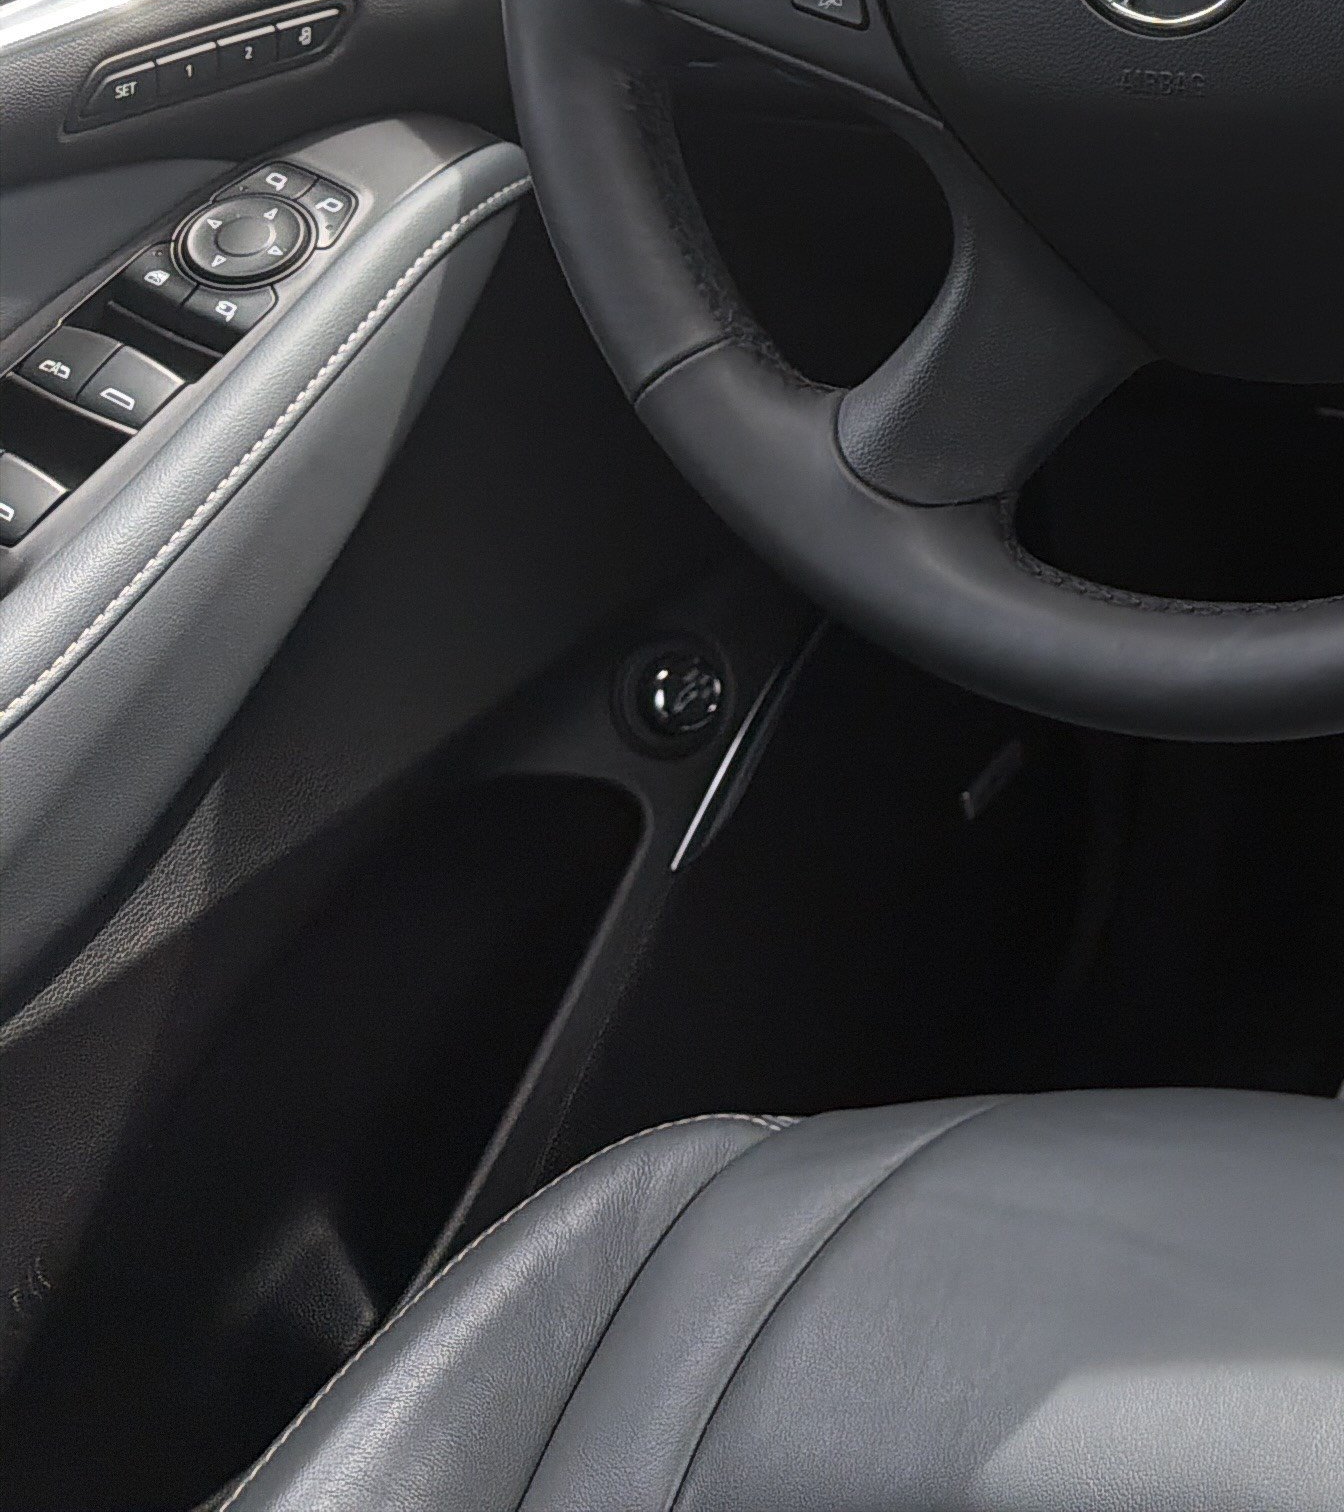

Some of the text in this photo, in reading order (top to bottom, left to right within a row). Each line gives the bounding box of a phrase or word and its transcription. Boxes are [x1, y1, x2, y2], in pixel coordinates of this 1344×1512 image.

[114, 46, 254, 99] SET 1 2
